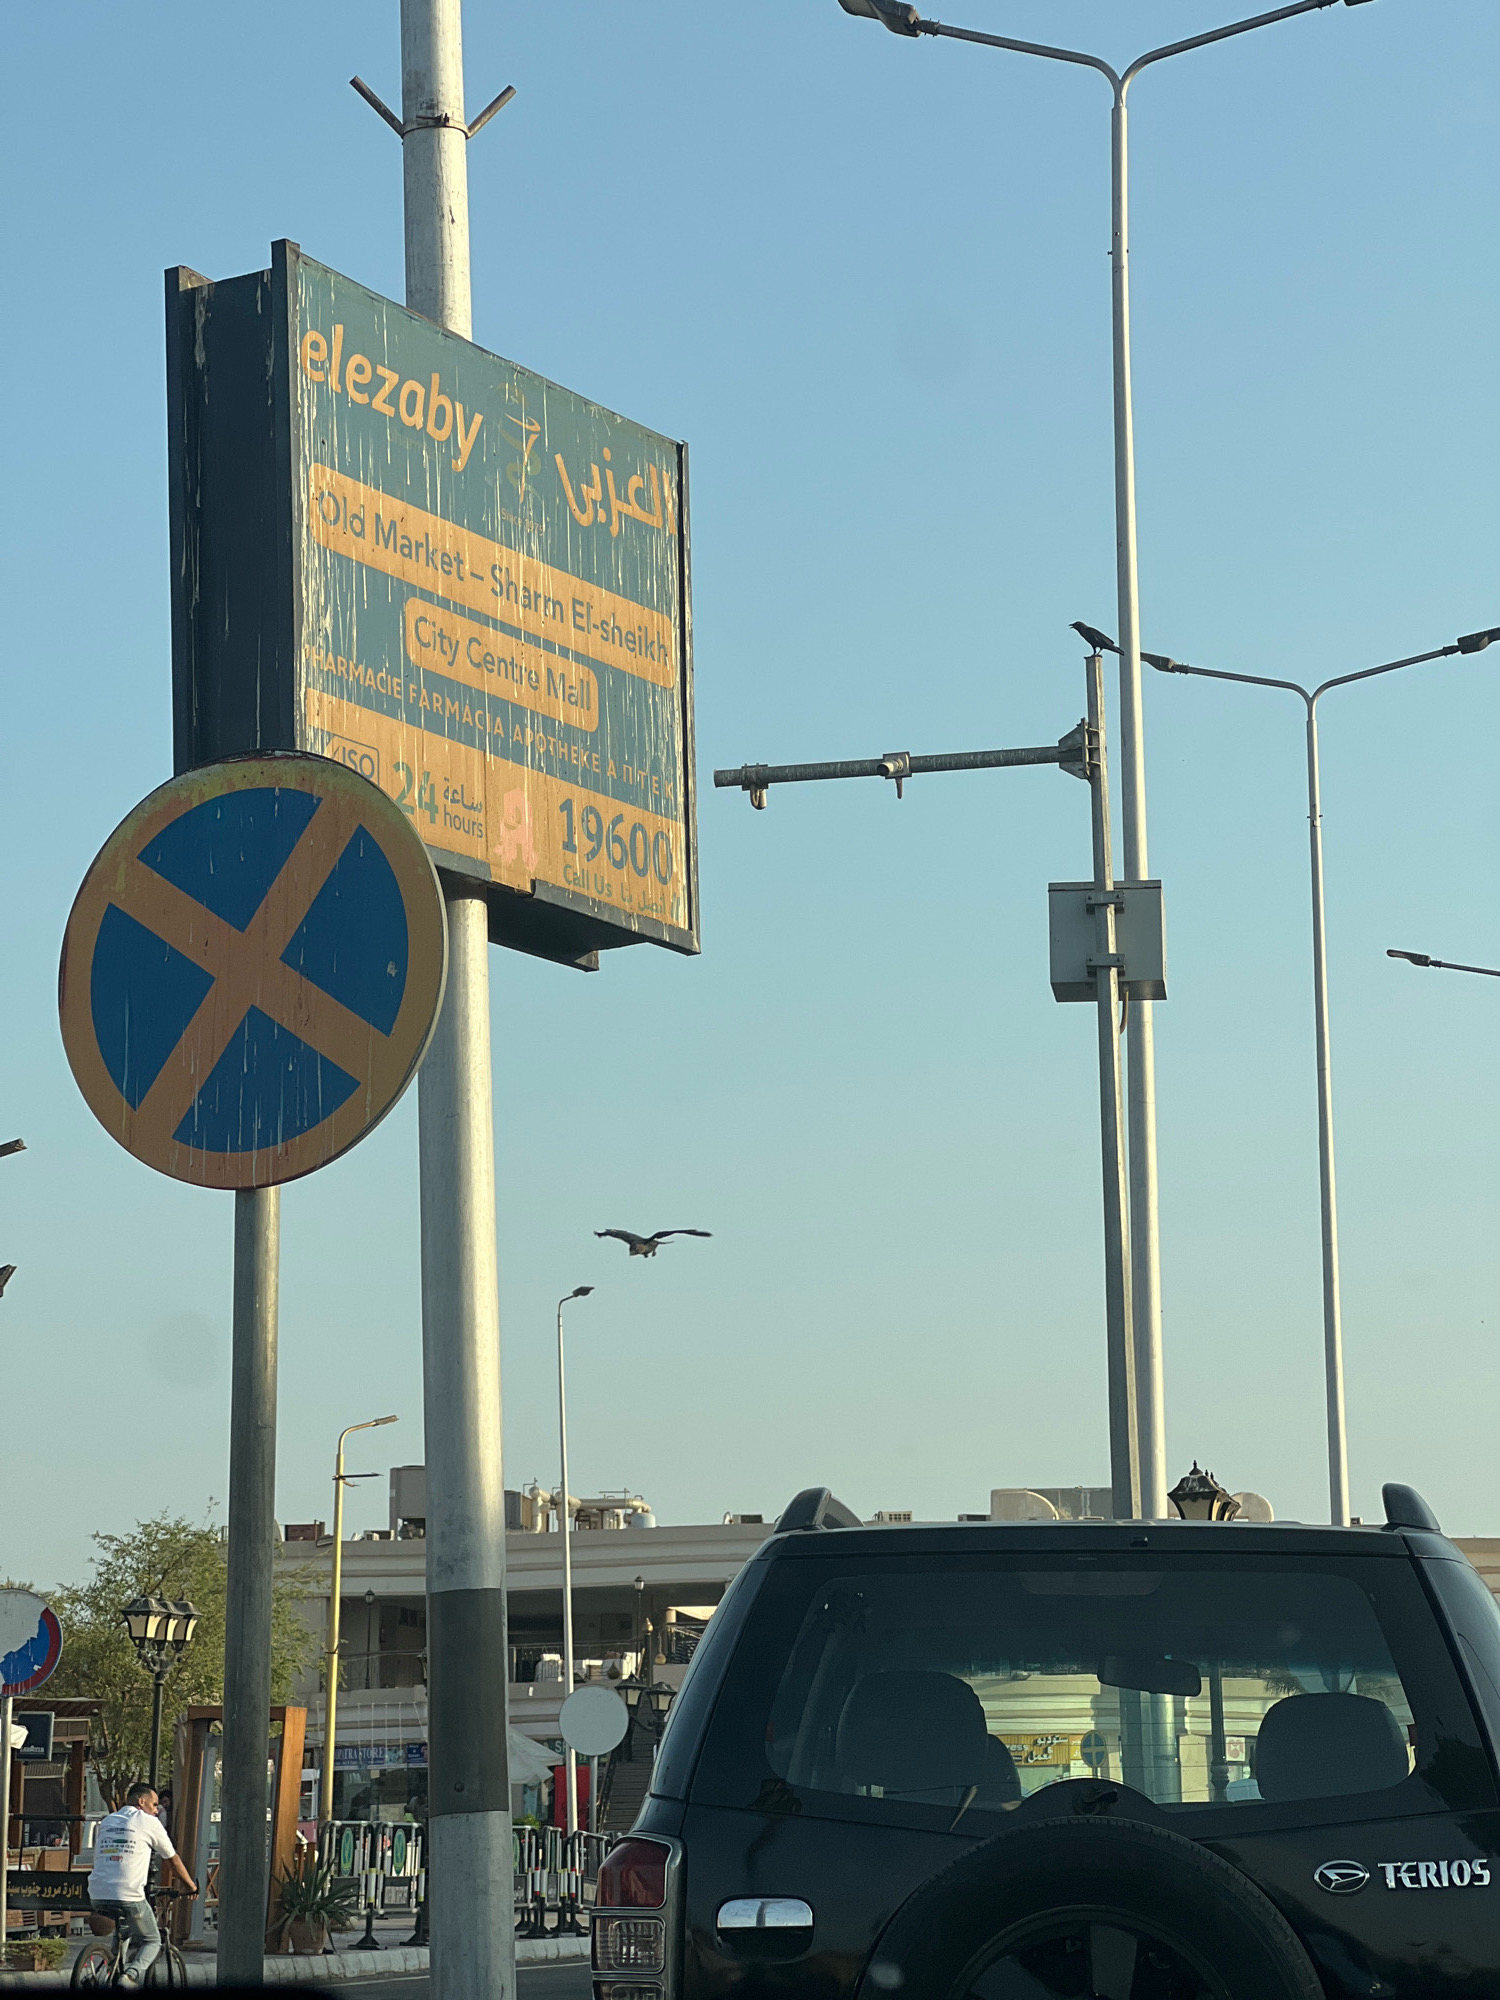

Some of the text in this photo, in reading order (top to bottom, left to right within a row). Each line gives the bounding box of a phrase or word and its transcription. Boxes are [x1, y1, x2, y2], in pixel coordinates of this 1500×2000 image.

[300, 323, 484, 472] elezaby
[501, 508, 522, 527] Since
[318, 489, 365, 541] Old
[374, 510, 464, 582] Market
[490, 564, 564, 624] Sharm
[571, 594, 670, 668] El-sheikh
[414, 616, 592, 712] City Centre Mall
[409, 683, 505, 738] FARMACIA
[513, 724, 601, 773] APOTHEKE
[343, 746, 375, 779] ISO
[393, 761, 439, 825] 24
[443, 777, 483, 811] ساعة
[443, 809, 484, 840] hours
[559, 798, 674, 886] 19600
[563, 863, 612, 899] Call Us
[1006, 1744, 1029, 1752] ress
[6, 1880, 83, 1899] إدارة مرور جنوب سين
[1377, 1858, 1491, 1890] TERIOS
